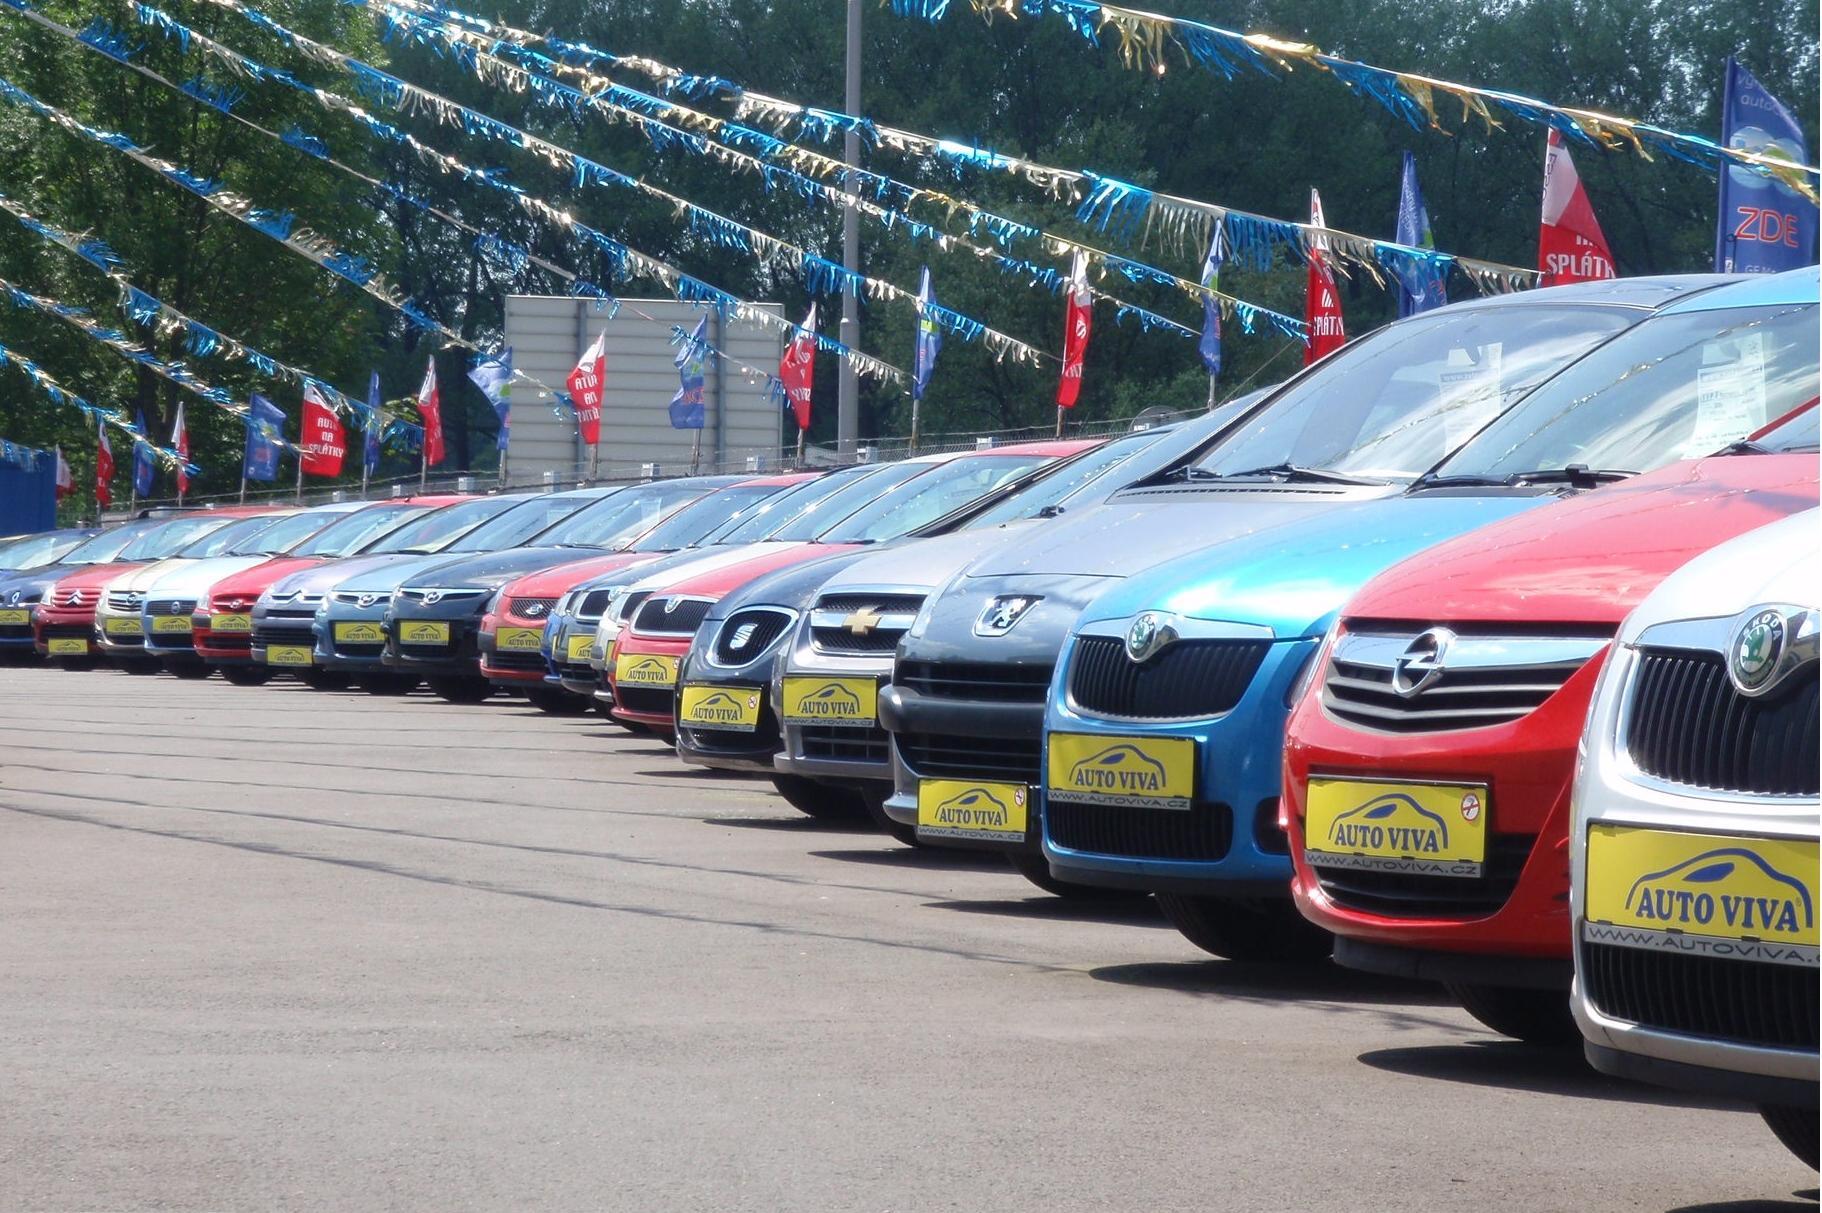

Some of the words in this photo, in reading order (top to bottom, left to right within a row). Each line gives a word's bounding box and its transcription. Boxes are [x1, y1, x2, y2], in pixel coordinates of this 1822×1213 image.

[1735, 206, 1798, 248] ZDE
[1546, 250, 1616, 279] SPLÁTK
[321, 431, 334, 442] NA
[628, 670, 646, 680] AUTO
[647, 671, 665, 681] VIVA
[693, 707, 714, 719] AUTO
[716, 708, 738, 720] VIVA
[801, 701, 828, 714] AUTO
[830, 702, 856, 715] VIVA
[1075, 768, 1116, 788] AUTO
[1119, 771, 1159, 790] VIVA
[1049, 792, 1188, 809] WWW.AUTOVIVA.CZ
[939, 807, 971, 824] AUTO
[973, 810, 1003, 826] VIVA
[919, 828, 1023, 840] WWW.AUTOVIVA.CZ
[1334, 823, 1383, 849] AUTO
[1387, 827, 1440, 853] VIVA
[1306, 853, 1478, 875] WWW.AUTOVIVA.CZ
[1636, 887, 1715, 925] AUTO
[1720, 895, 1800, 933] VIVA
